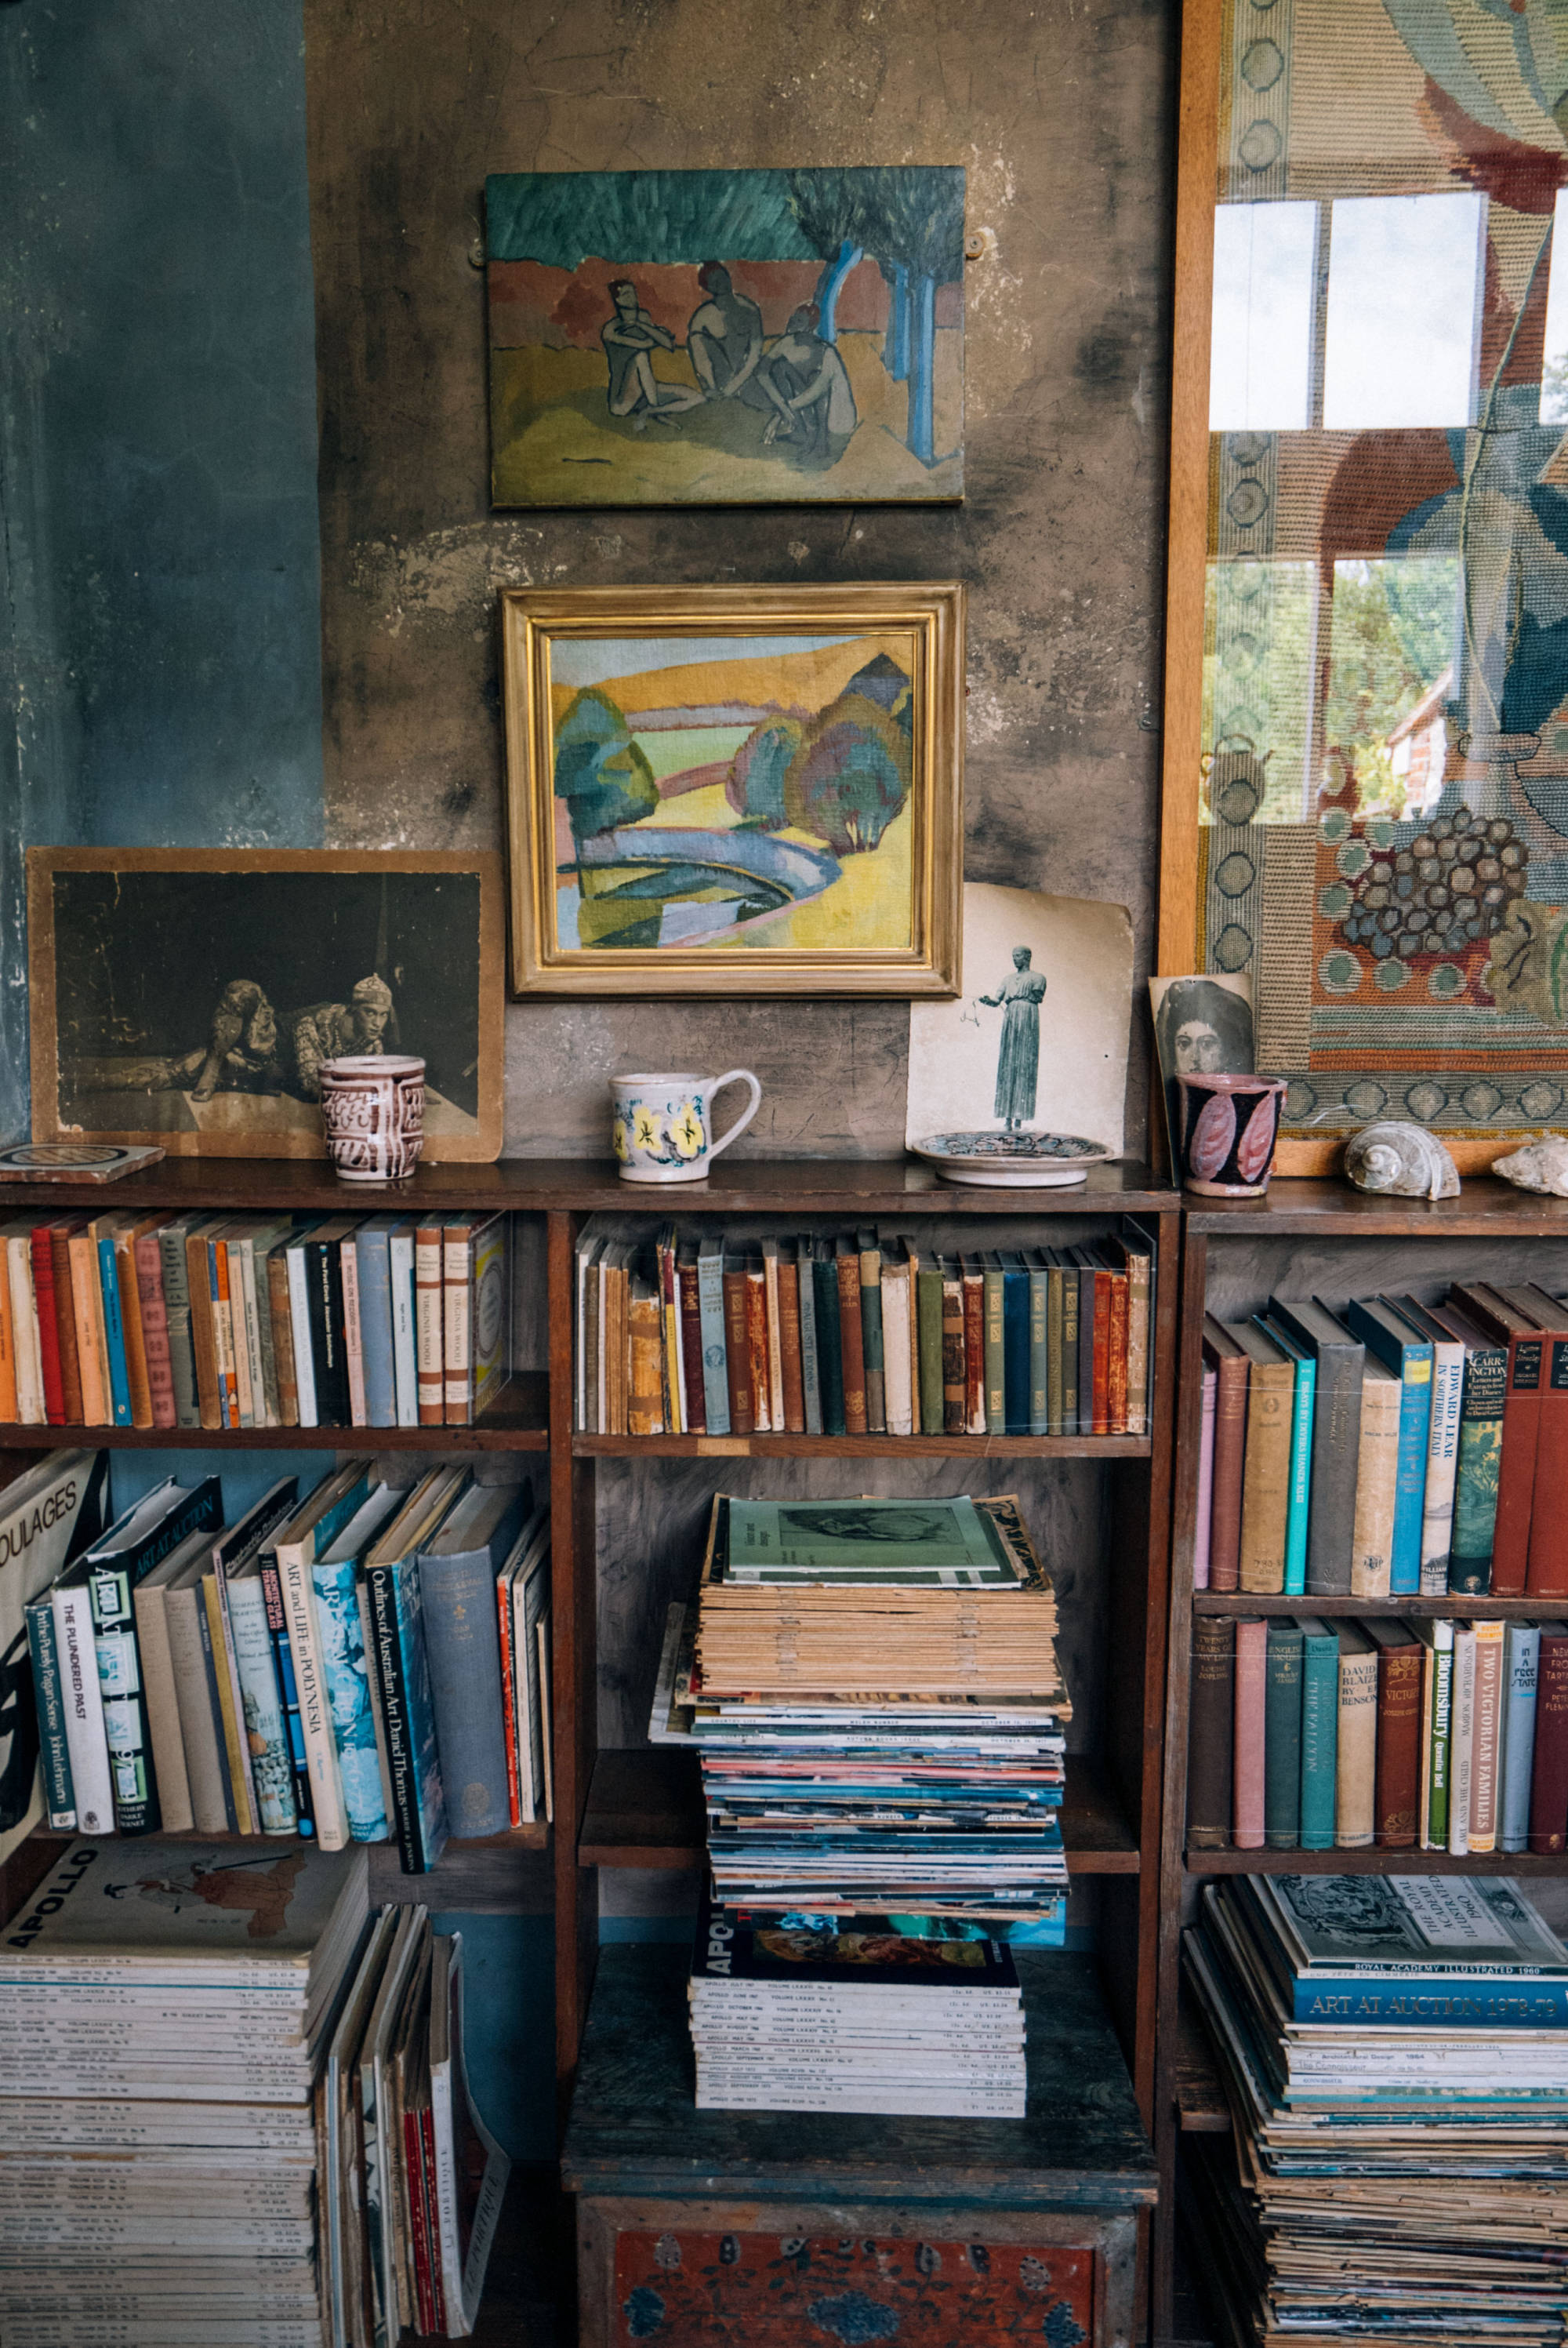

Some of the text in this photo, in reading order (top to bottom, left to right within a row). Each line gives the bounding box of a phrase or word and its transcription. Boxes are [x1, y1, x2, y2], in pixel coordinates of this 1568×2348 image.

[802, 1312, 815, 1382] AUGUSTE RODIN
[1516, 1354, 1539, 1363] Strachey
[1468, 1367, 1507, 1377] INGTON
[1298, 1381, 1310, 1482] ESSAYS BY DIVERS HANDS
[1431, 1365, 1447, 1457] IN SOUTHERN ITALY
[1444, 1365, 1460, 1458] EDWARD LEAR
[0, 1481, 76, 1567] OULAGES
[169, 1496, 214, 1541] AUCTION
[95, 1568, 122, 1640] ART AT
[261, 1569, 278, 1629] STAINED GLASS
[269, 1569, 284, 1629] ARCHITECTURAL
[371, 1570, 389, 1620] Outlines
[286, 1562, 321, 1734] ART and LIFE in POLYNESIA
[376, 1622, 392, 1634] of
[39, 1638, 53, 1669] Purely
[64, 1604, 85, 1719] THE PLUNDERED PAST
[379, 1634, 401, 1694] Australian
[1342, 1666, 1375, 1676] DAVID
[1462, 1645, 1473, 1699] RICHARDSON
[1514, 1668, 1535, 1677] FREE
[1523, 1658, 1529, 1666] A
[40, 1669, 56, 1699] Pagan
[1341, 1695, 1377, 1706] BENSON
[1342, 1674, 1377, 1685] BLAIZE
[1342, 1687, 1354, 1696] BY
[1512, 1677, 1536, 1687] STATE
[45, 1700, 59, 1730] Sense
[387, 1695, 402, 1715] Art
[1306, 1677, 1318, 1772] THE FALCON
[1433, 1654, 1451, 1787] Bloomsbury Quentin Bell
[1461, 1704, 1471, 1736] MARION
[49, 1736, 62, 1757] John
[389, 1719, 406, 1757] Daniel
[1476, 1648, 1496, 1828] TWO VICTORIAN FAMILIES
[52, 1757, 66, 1804] Lehmann
[392, 1757, 408, 1805] Thomas
[1461, 1761, 1469, 1785] CHILD
[7, 1849, 99, 1949] APOLLO
[1399, 1881, 1440, 1934] THE ROYAL
[1417, 1885, 1456, 1931] ACADEMY
[1428, 1875, 1478, 1938] ILLUSTRATED
[1457, 1895, 1483, 1919] 1960
[1390, 1964, 1439, 1972] ACADEMY
[1444, 1965, 1513, 1974] ILLUSTRATED
[1309, 1996, 1557, 2017] ART AT AUCTION 1978-79
[1299, 2061, 1367, 2070] The Connoisseur
[441, 2147, 452, 2223] PORTIQUE
